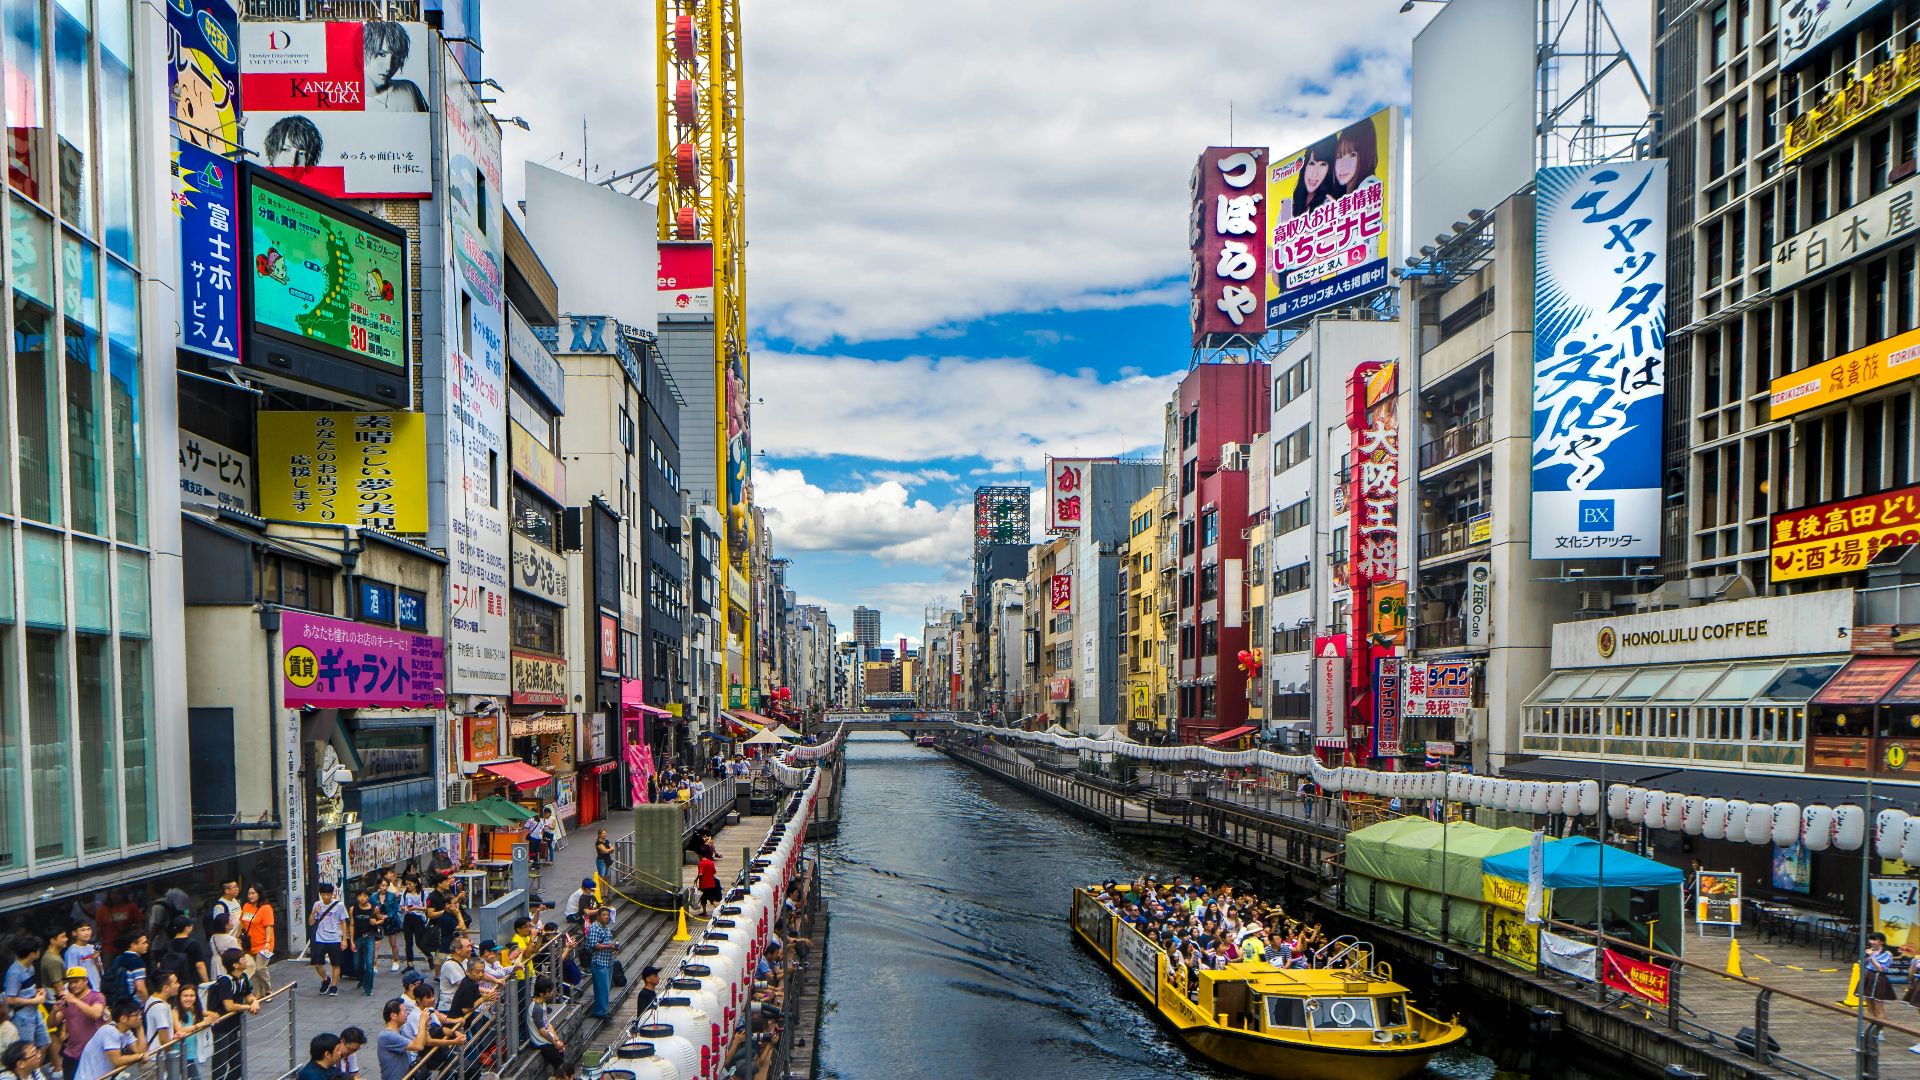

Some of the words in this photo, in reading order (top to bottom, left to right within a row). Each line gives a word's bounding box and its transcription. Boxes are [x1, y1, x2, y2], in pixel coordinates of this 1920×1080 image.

[291, 78, 360, 98] KANZAKI
[316, 91, 360, 108] RUKA
[340, 151, 415, 162] めっちゃ面白いを
[1273, 183, 1383, 245] 高収入お仕事情報
[1216, 148, 1263, 326] づぼらや
[1272, 204, 1382, 272] いちごナビ
[1804, 190, 1916, 275] 白木屋
[1776, 239, 1798, 266] 4F
[207, 201, 234, 352] 富士ホーム
[1288, 263, 1326, 285] いちごナビ
[1326, 256, 1343, 272] 求人
[190, 260, 207, 339] サービス
[1269, 266, 1385, 318] 店舗・スタッフ求人も掲載中!
[350, 324, 367, 352] 30
[315, 415, 338, 521] あなたのお店づくり
[290, 454, 313, 513] 応援します
[1358, 420, 1398, 580] 大阪王将
[1584, 507, 1610, 523] BX
[1797, 538, 1864, 573] 酒場
[370, 589, 379, 615] 酒
[1060, 576, 1069, 599] ツルハ
[1472, 583, 1484, 615] ZERO
[303, 623, 409, 651] あなたも憧れのお店のオーナーに!
[1621, 626, 1698, 648] HONOLULU
[1701, 619, 1769, 640] COFFEE
[288, 655, 315, 679] 賃貸
[319, 647, 411, 695] ギャラント
[1409, 665, 1425, 695] 薬
[1428, 667, 1469, 686] ダイコク
[316, 681, 324, 693] の
[1382, 678, 1395, 718] ダイコク
[1425, 700, 1451, 715] 免税
